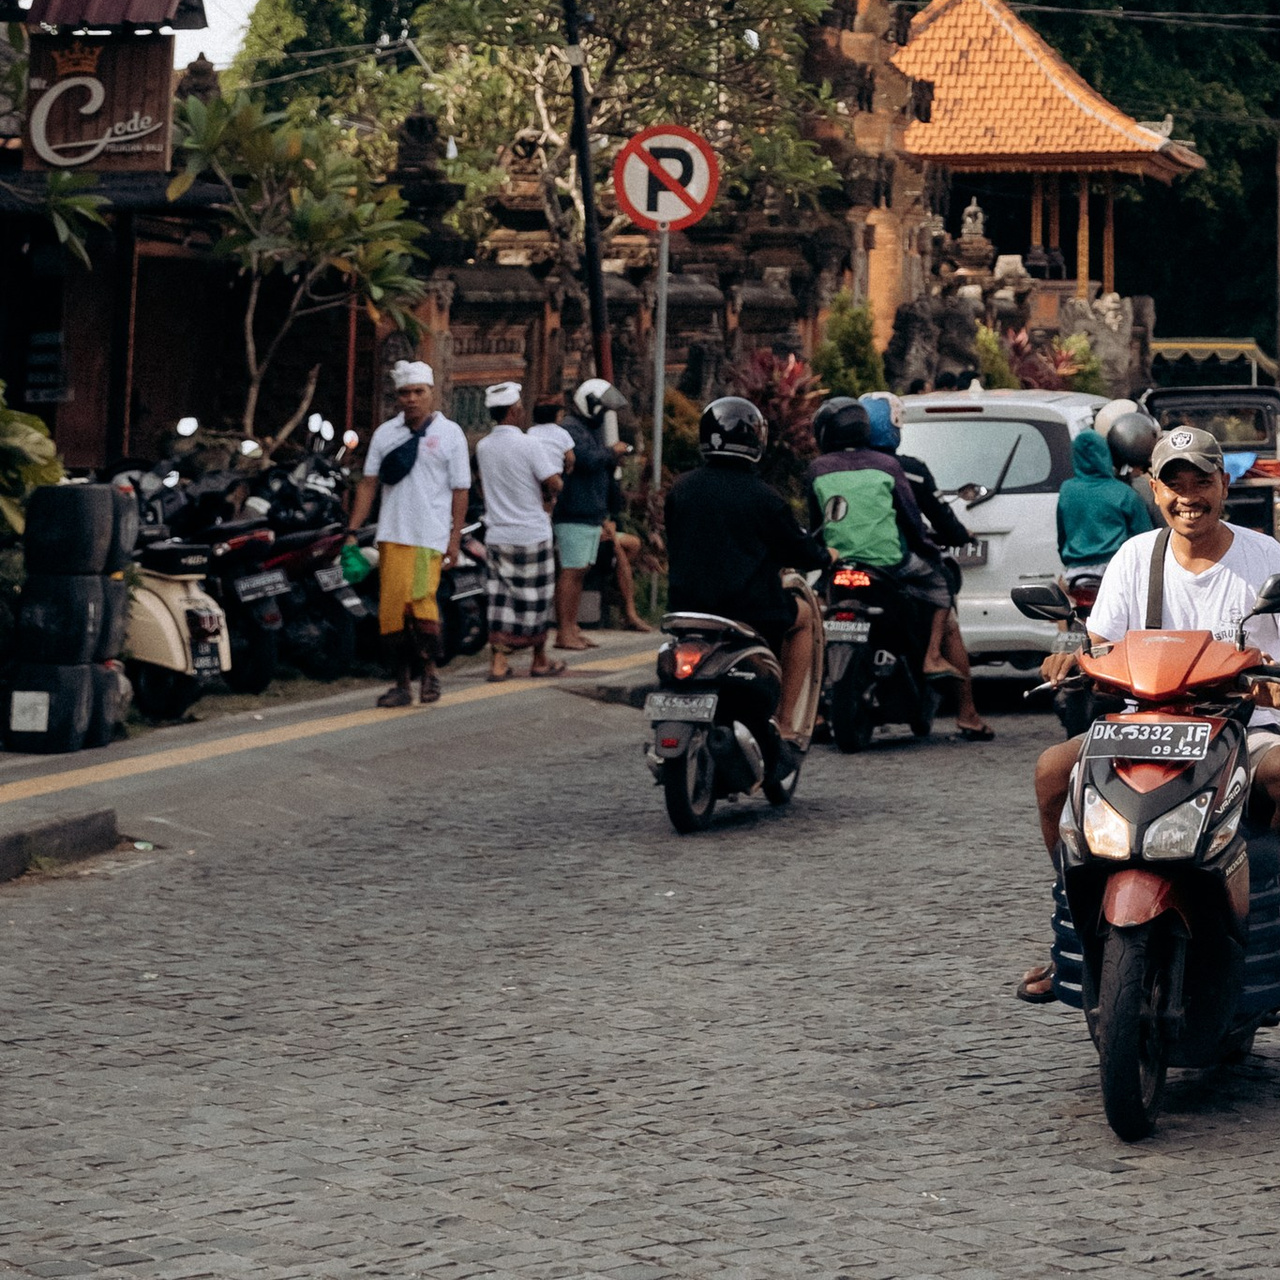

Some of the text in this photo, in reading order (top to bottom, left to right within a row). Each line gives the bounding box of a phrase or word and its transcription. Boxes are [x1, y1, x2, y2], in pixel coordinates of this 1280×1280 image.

[646, 147, 693, 211] P
[1092, 724, 1208, 742] DK 5332 IF
[1214, 783, 1242, 815] VARIO
